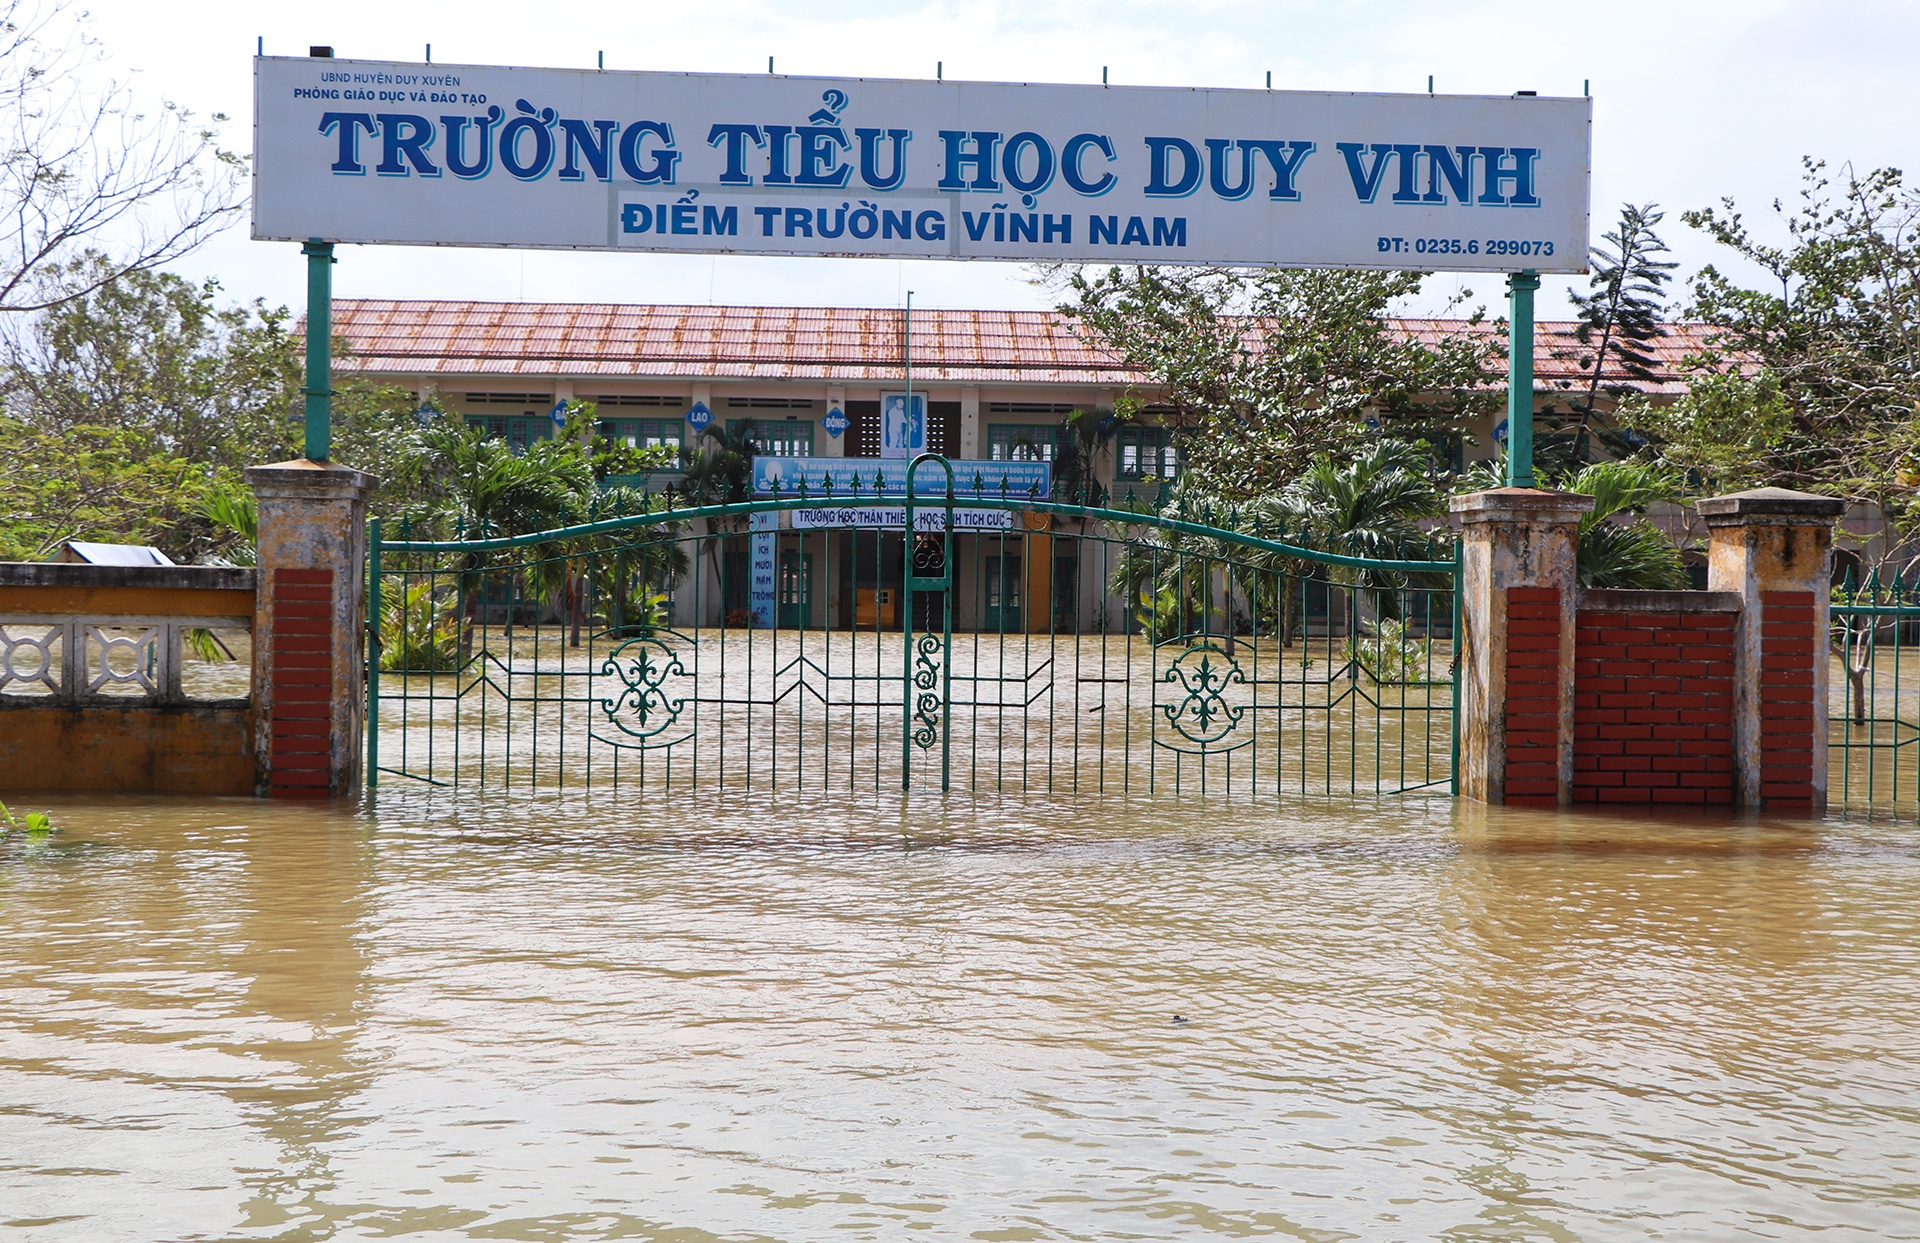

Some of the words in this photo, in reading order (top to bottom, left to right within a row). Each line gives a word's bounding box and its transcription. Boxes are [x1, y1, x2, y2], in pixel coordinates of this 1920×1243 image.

[321, 72, 351, 83] UBND
[354, 72, 393, 85] HUYỆN
[395, 75, 419, 85] DUY
[421, 74, 461, 86] XUYÊN
[294, 86, 340, 100] PHÒNG
[343, 87, 376, 101] GIÁO
[379, 91, 406, 104] DỤC
[409, 90, 427, 102] VÀ
[430, 90, 458, 103] ĐÀO
[462, 93, 488, 106] TẠO
[318, 99, 681, 186] TRƯỜNG
[707, 89, 914, 192] TIỂU
[938, 130, 1119, 209] HỌC
[1144, 136, 1317, 202] DUY
[1337, 141, 1541, 208] VINH
[621, 189, 738, 236] ĐIỂM
[754, 200, 946, 241] TRƯỜNG
[962, 203, 1072, 245] VĨNH
[1088, 215, 1187, 248] NAM
[1377, 236, 1409, 253] ĐT:
[1414, 238, 1479, 255] 0235.6
[1485, 239, 1555, 257] 299073
[691, 412, 708, 423] LAO
[826, 415, 845, 431] ĐỘNG
[859, 508, 883, 524] THÂN
[963, 510, 985, 526] TÍCH
